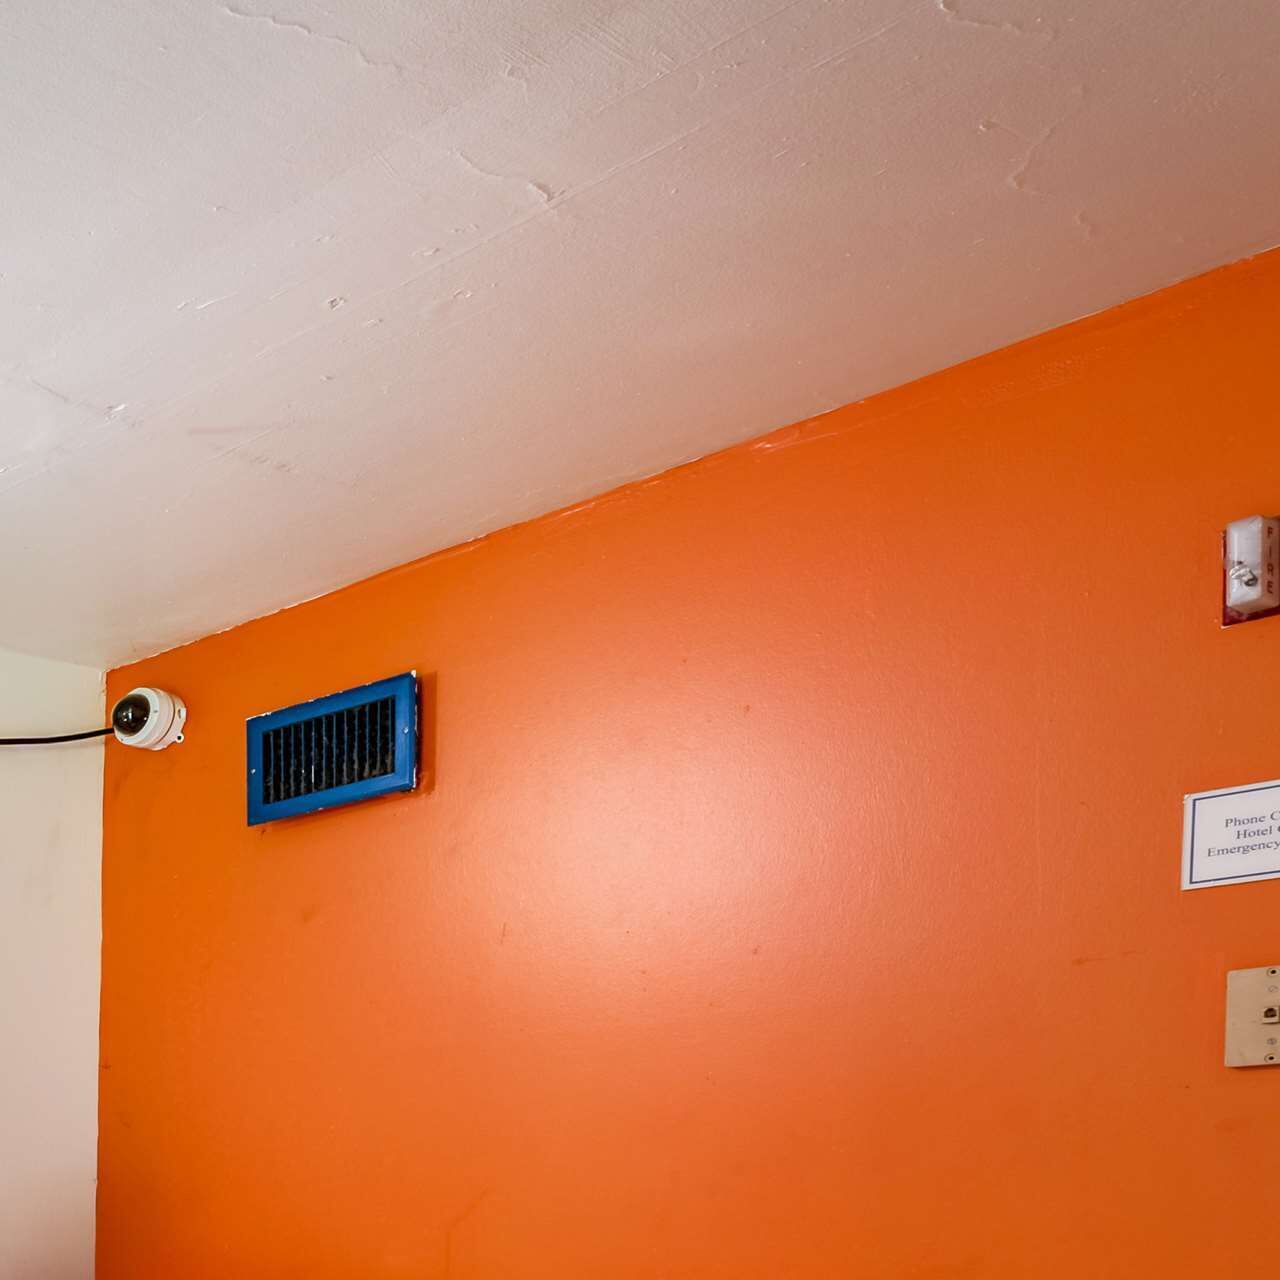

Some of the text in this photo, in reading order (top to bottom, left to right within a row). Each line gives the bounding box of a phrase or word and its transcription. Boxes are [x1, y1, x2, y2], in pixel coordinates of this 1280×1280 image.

[1266, 526, 1275, 595] FIRE
[1225, 815, 1267, 828] Phone
[1236, 825, 1273, 839] Hotel
[1207, 840, 1280, 857] Emergency
